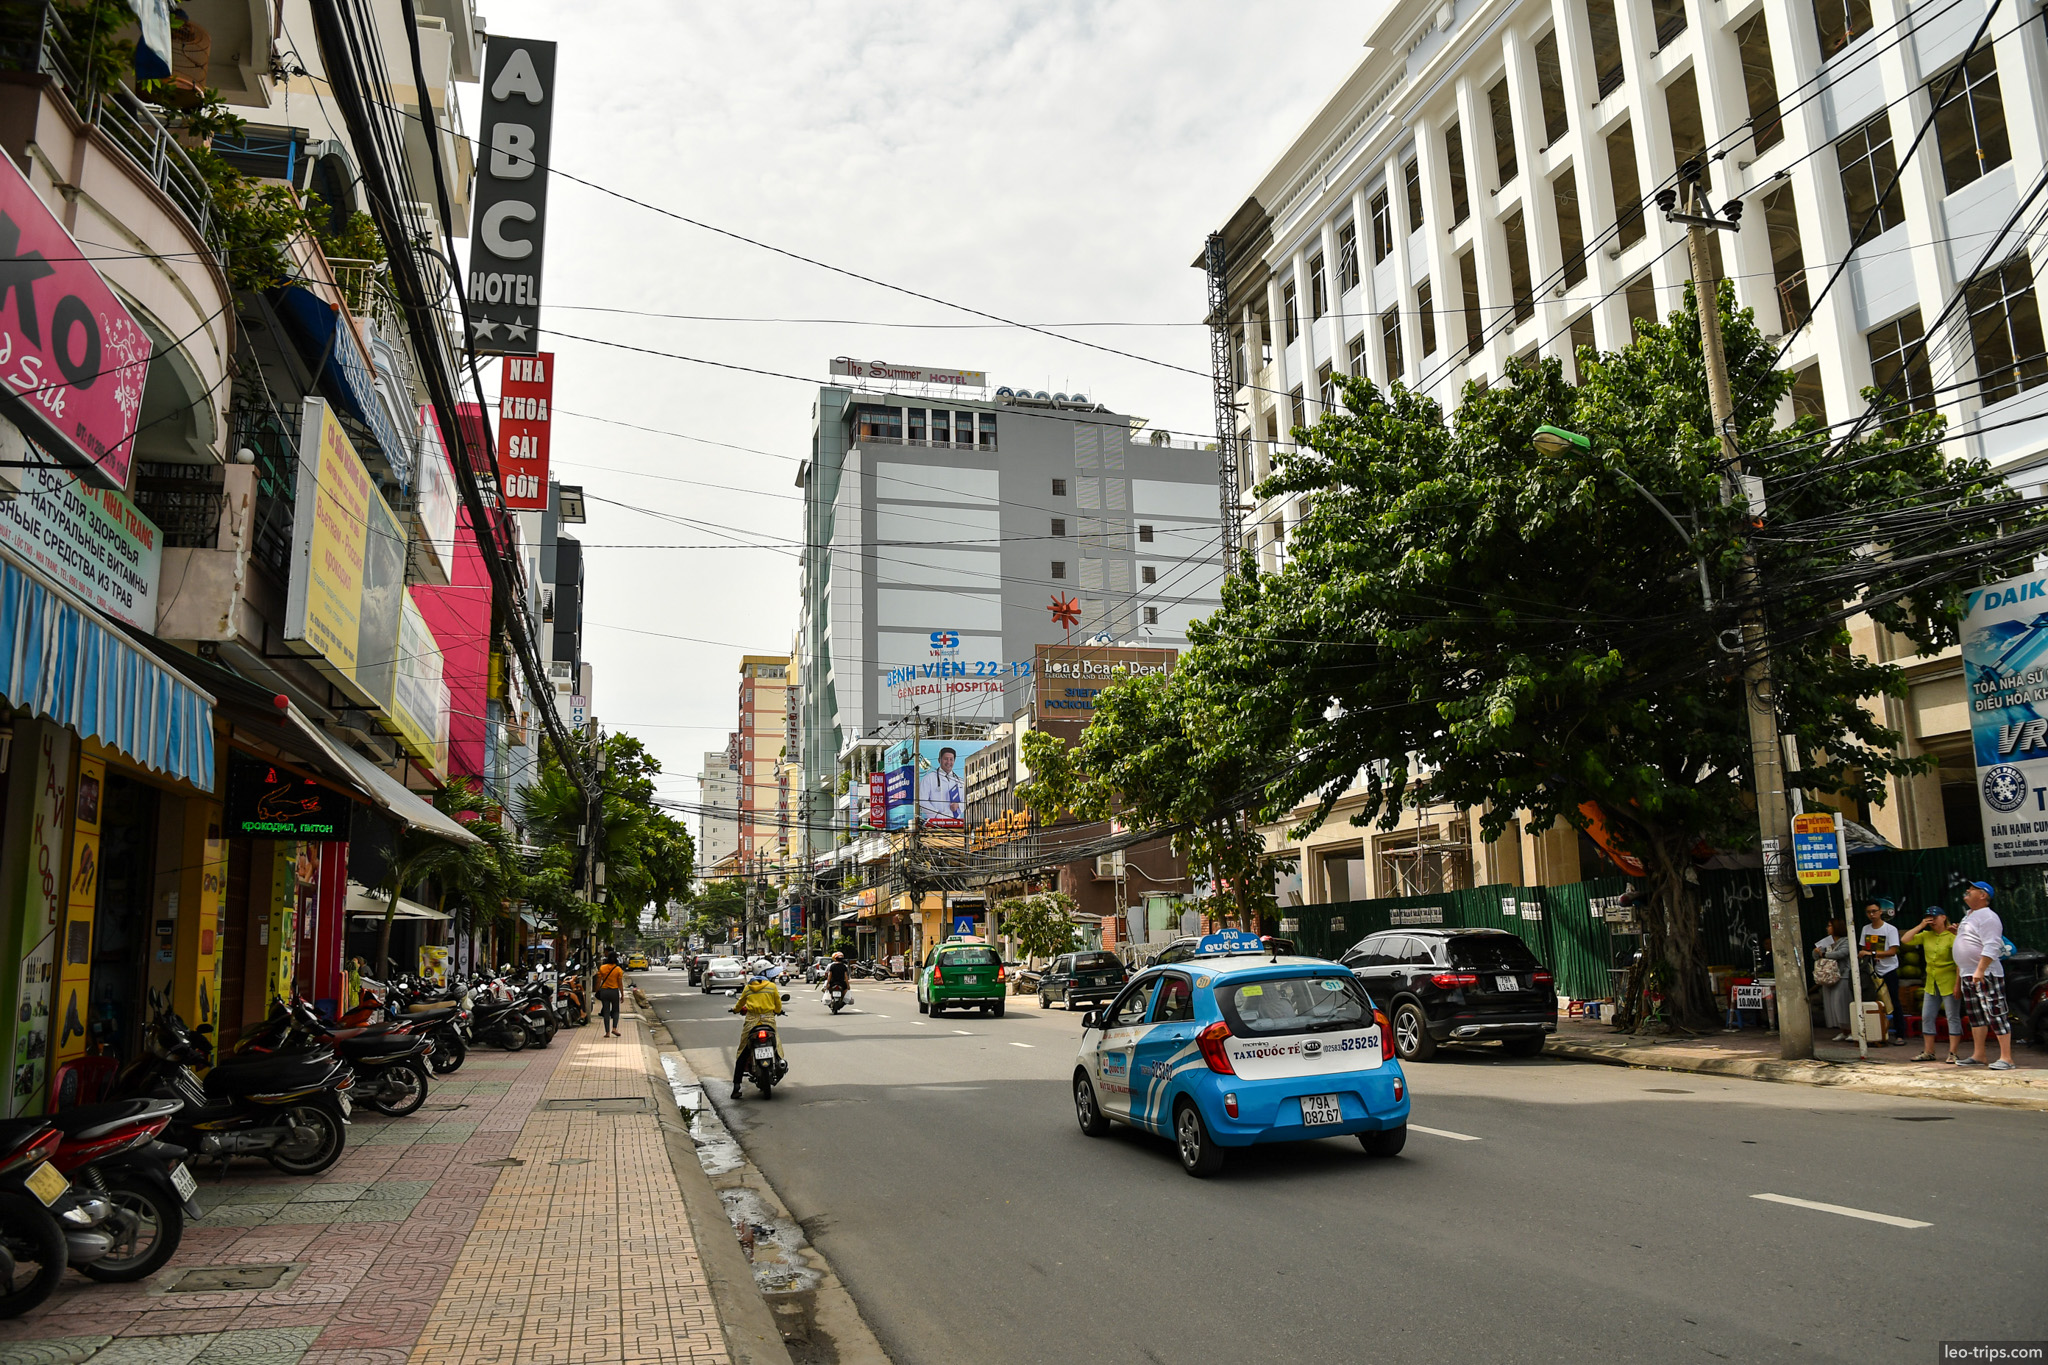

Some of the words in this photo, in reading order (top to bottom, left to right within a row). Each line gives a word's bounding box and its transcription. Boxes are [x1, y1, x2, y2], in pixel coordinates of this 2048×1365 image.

[481, 48, 544, 261] ABC
[470, 272, 538, 307] HOTEL
[509, 359, 545, 383] NHA
[835, 356, 862, 380] The
[869, 360, 922, 380] Summer
[929, 373, 968, 385] HOTEL
[8, 355, 66, 419] Silk
[502, 396, 548, 421] KHOA
[509, 428, 539, 459] SÀI
[505, 467, 539, 499] GÒN
[31, 488, 106, 564] НАТУРАЛЬНЫЕ
[38, 466, 63, 501] ВСЁ
[63, 489, 87, 522] ДЛЯ
[88, 511, 140, 568] ЗДОРОВЬЯ
[103, 489, 122, 524] NHA
[125, 507, 154, 551] TRANG
[317, 495, 342, 544] Вьетнам
[345, 534, 363, 573] Россия
[43, 528, 96, 583] СРЕДСТВА
[97, 570, 110, 593] ИЗ
[111, 580, 133, 609] ТРАВ
[325, 547, 353, 592] крокодил
[1984, 578, 2047, 611] DAIK
[887, 665, 916, 687] BỆNH
[922, 658, 966, 681] VIỆN
[1044, 658, 1080, 679] Long
[1082, 660, 1127, 675] Beach
[1129, 661, 1168, 677] Pearl
[1973, 679, 1997, 695] TÒA
[2000, 675, 2025, 690] NHÀ
[2027, 666, 2045, 684] SỬ
[571, 696, 585, 706] MD
[897, 683, 942, 699] GENERAL
[946, 682, 1005, 693] HOSPITAL
[1975, 694, 2003, 712] ĐIỀU
[2006, 690, 2031, 706] HÒA
[43, 734, 65, 830] ЧАЙ
[1991, 823, 2008, 837] HÂN
[2009, 822, 2032, 837] HẠNH
[34, 813, 57, 925] КОФЕ
[1994, 850, 2012, 859] Email:
[1204, 940, 1240, 952] QUỐC
[1243, 938, 1258, 949] TẾ
[1222, 930, 1238, 940] TAXI
[1326, 981, 1344, 990] 511
[1737, 988, 1750, 996] CAM
[1752, 987, 1761, 996] ÉP
[1288, 1041, 1301, 1055] TẾ
[1304, 1109, 1339, 1125] 082.67
[1309, 1096, 1331, 1110] 79A
